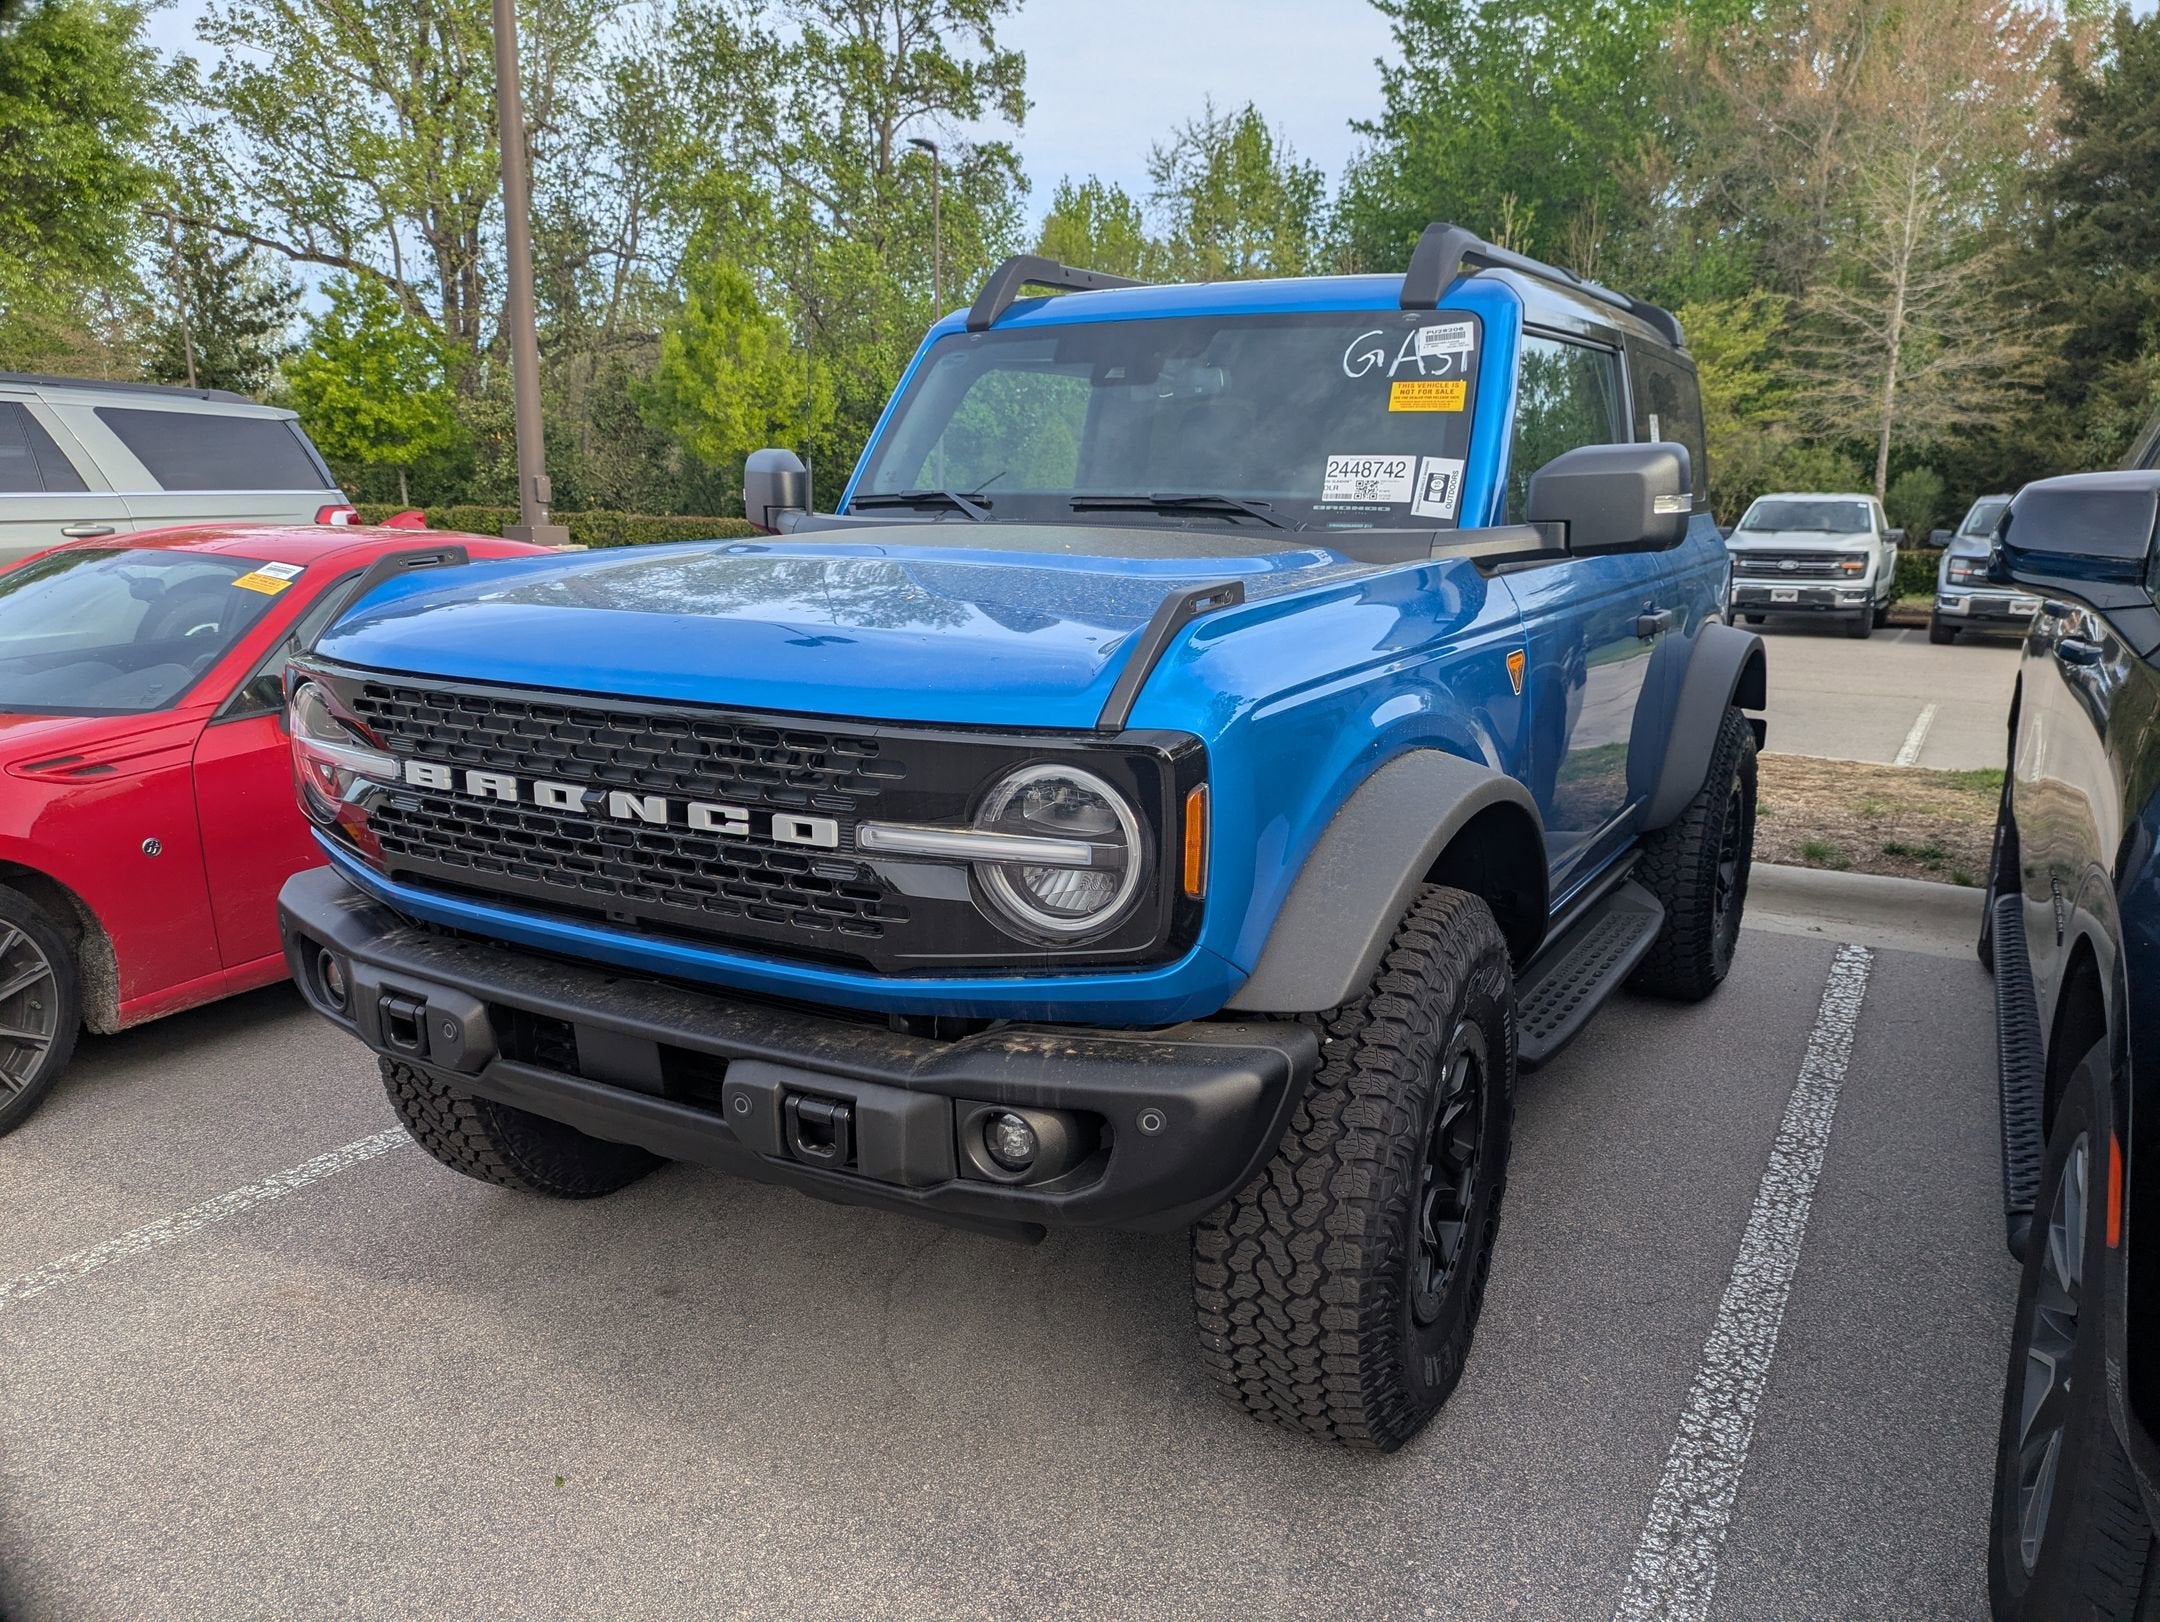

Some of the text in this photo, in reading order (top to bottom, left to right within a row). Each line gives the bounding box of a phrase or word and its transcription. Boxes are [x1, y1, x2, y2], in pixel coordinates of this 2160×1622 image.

[1327, 461, 1407, 479] 2448742
[1433, 480, 1441, 489] 15
[1445, 470, 1459, 510] OUTDOORS
[404, 759, 839, 848] BRONCO
